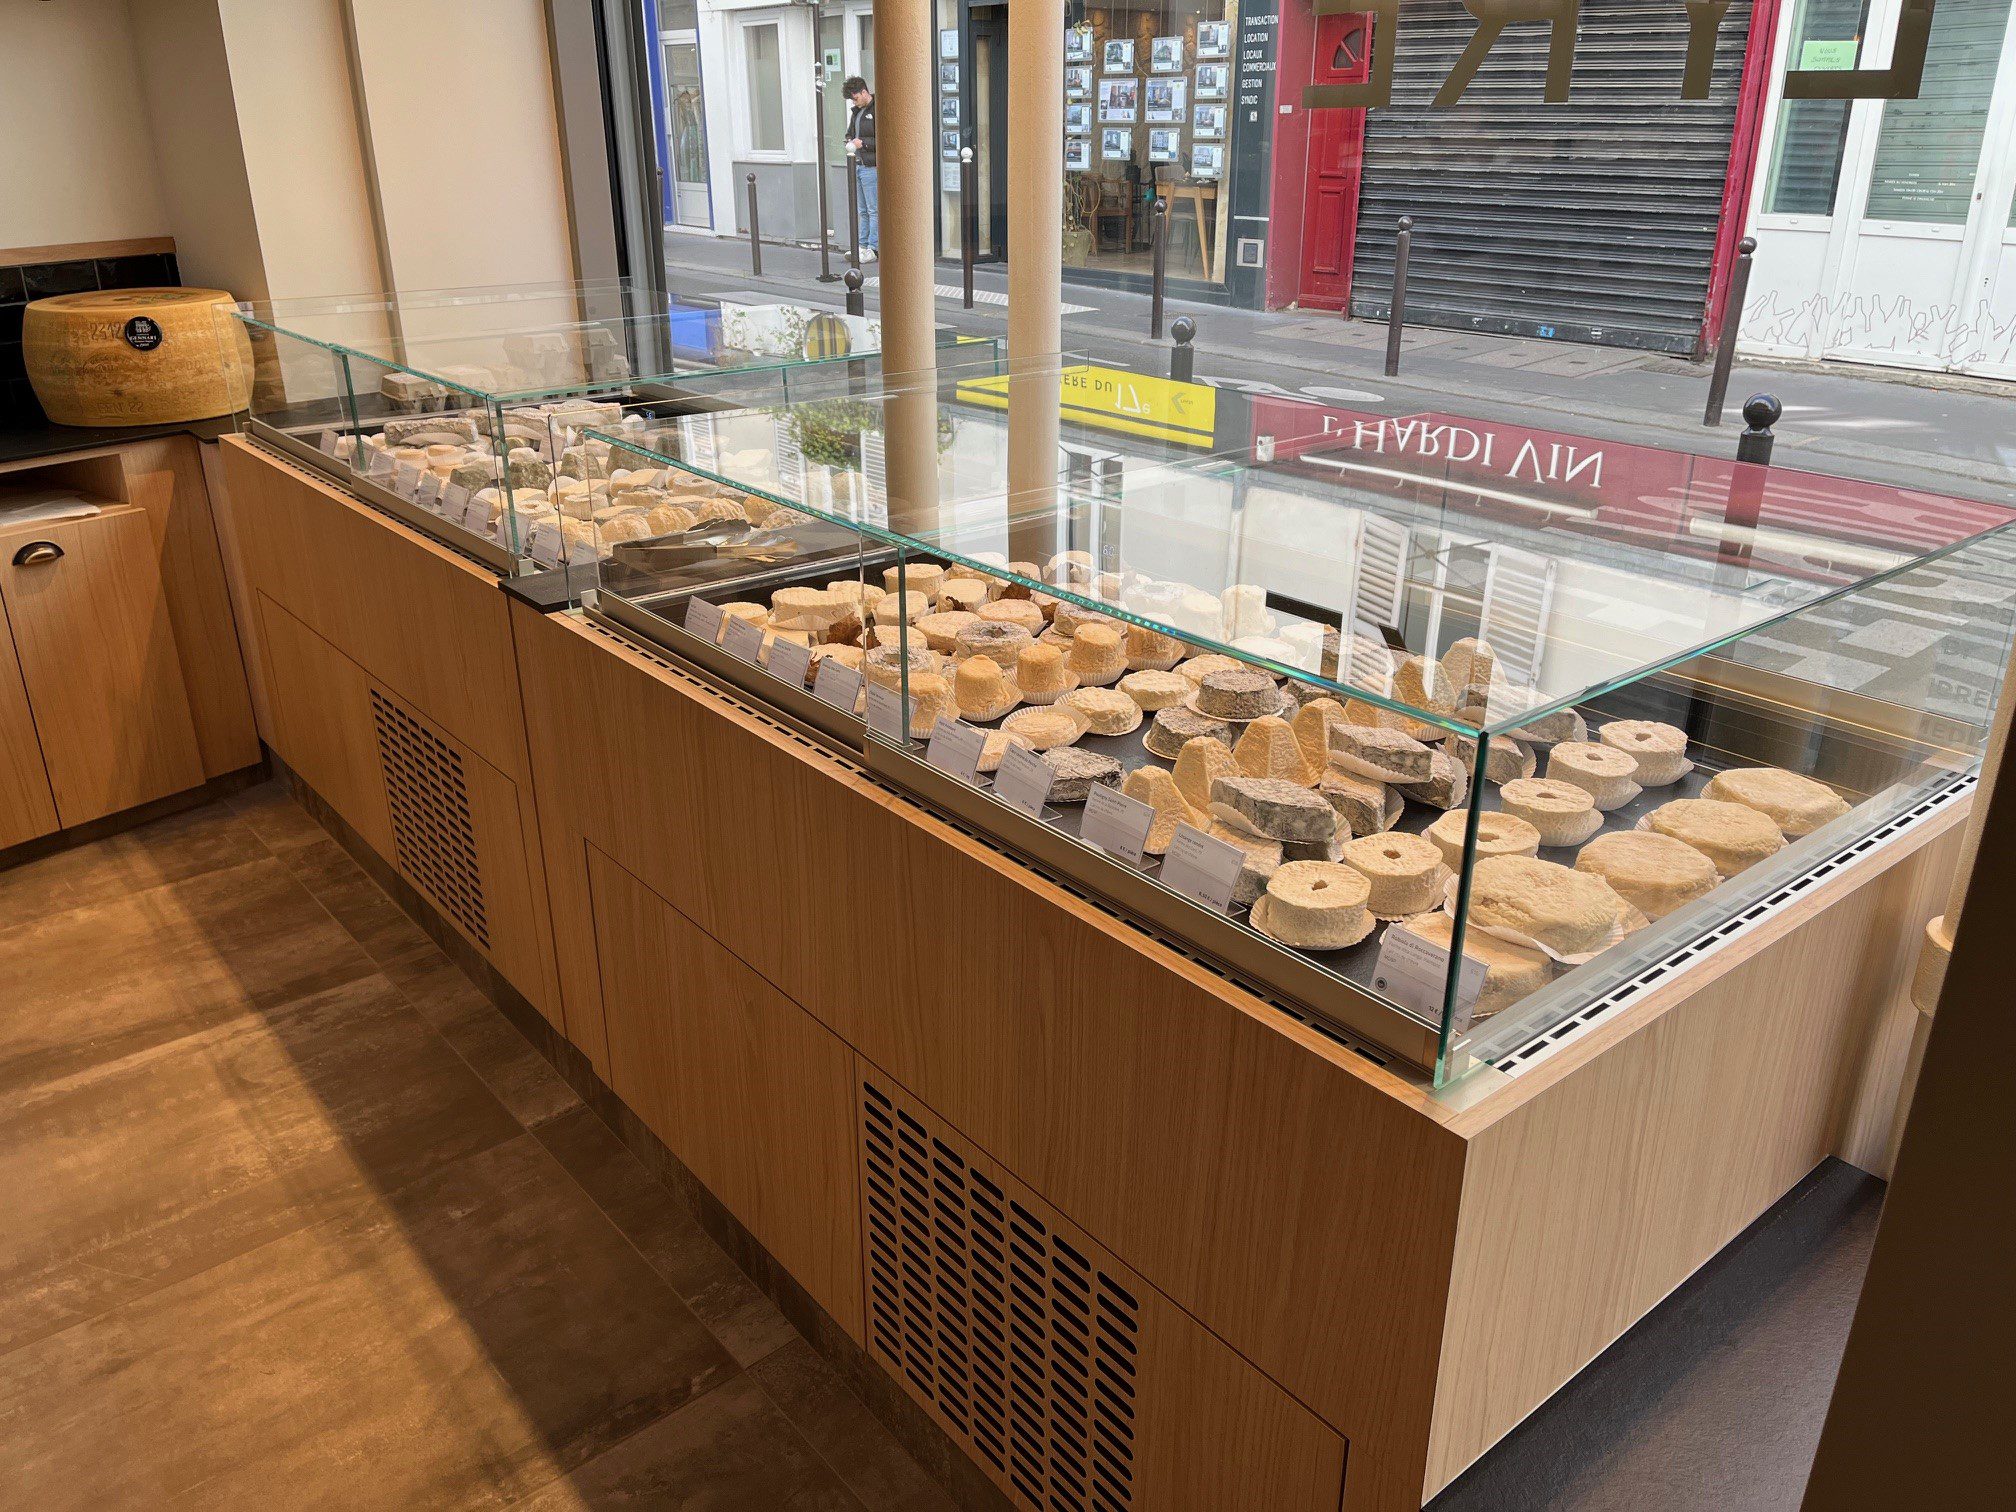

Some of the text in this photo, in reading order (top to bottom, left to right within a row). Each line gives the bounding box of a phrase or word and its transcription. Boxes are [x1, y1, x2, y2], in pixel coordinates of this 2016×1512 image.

[1245, 14, 1279, 26] TRANSACTION
[1244, 32, 1269, 43] LOCATION
[1243, 49, 1263, 60] LOCAUX
[1242, 61, 1277, 72] COMMERCIAUX
[1241, 78, 1263, 88] GESTION
[1240, 94, 1259, 104] SYNDIC
